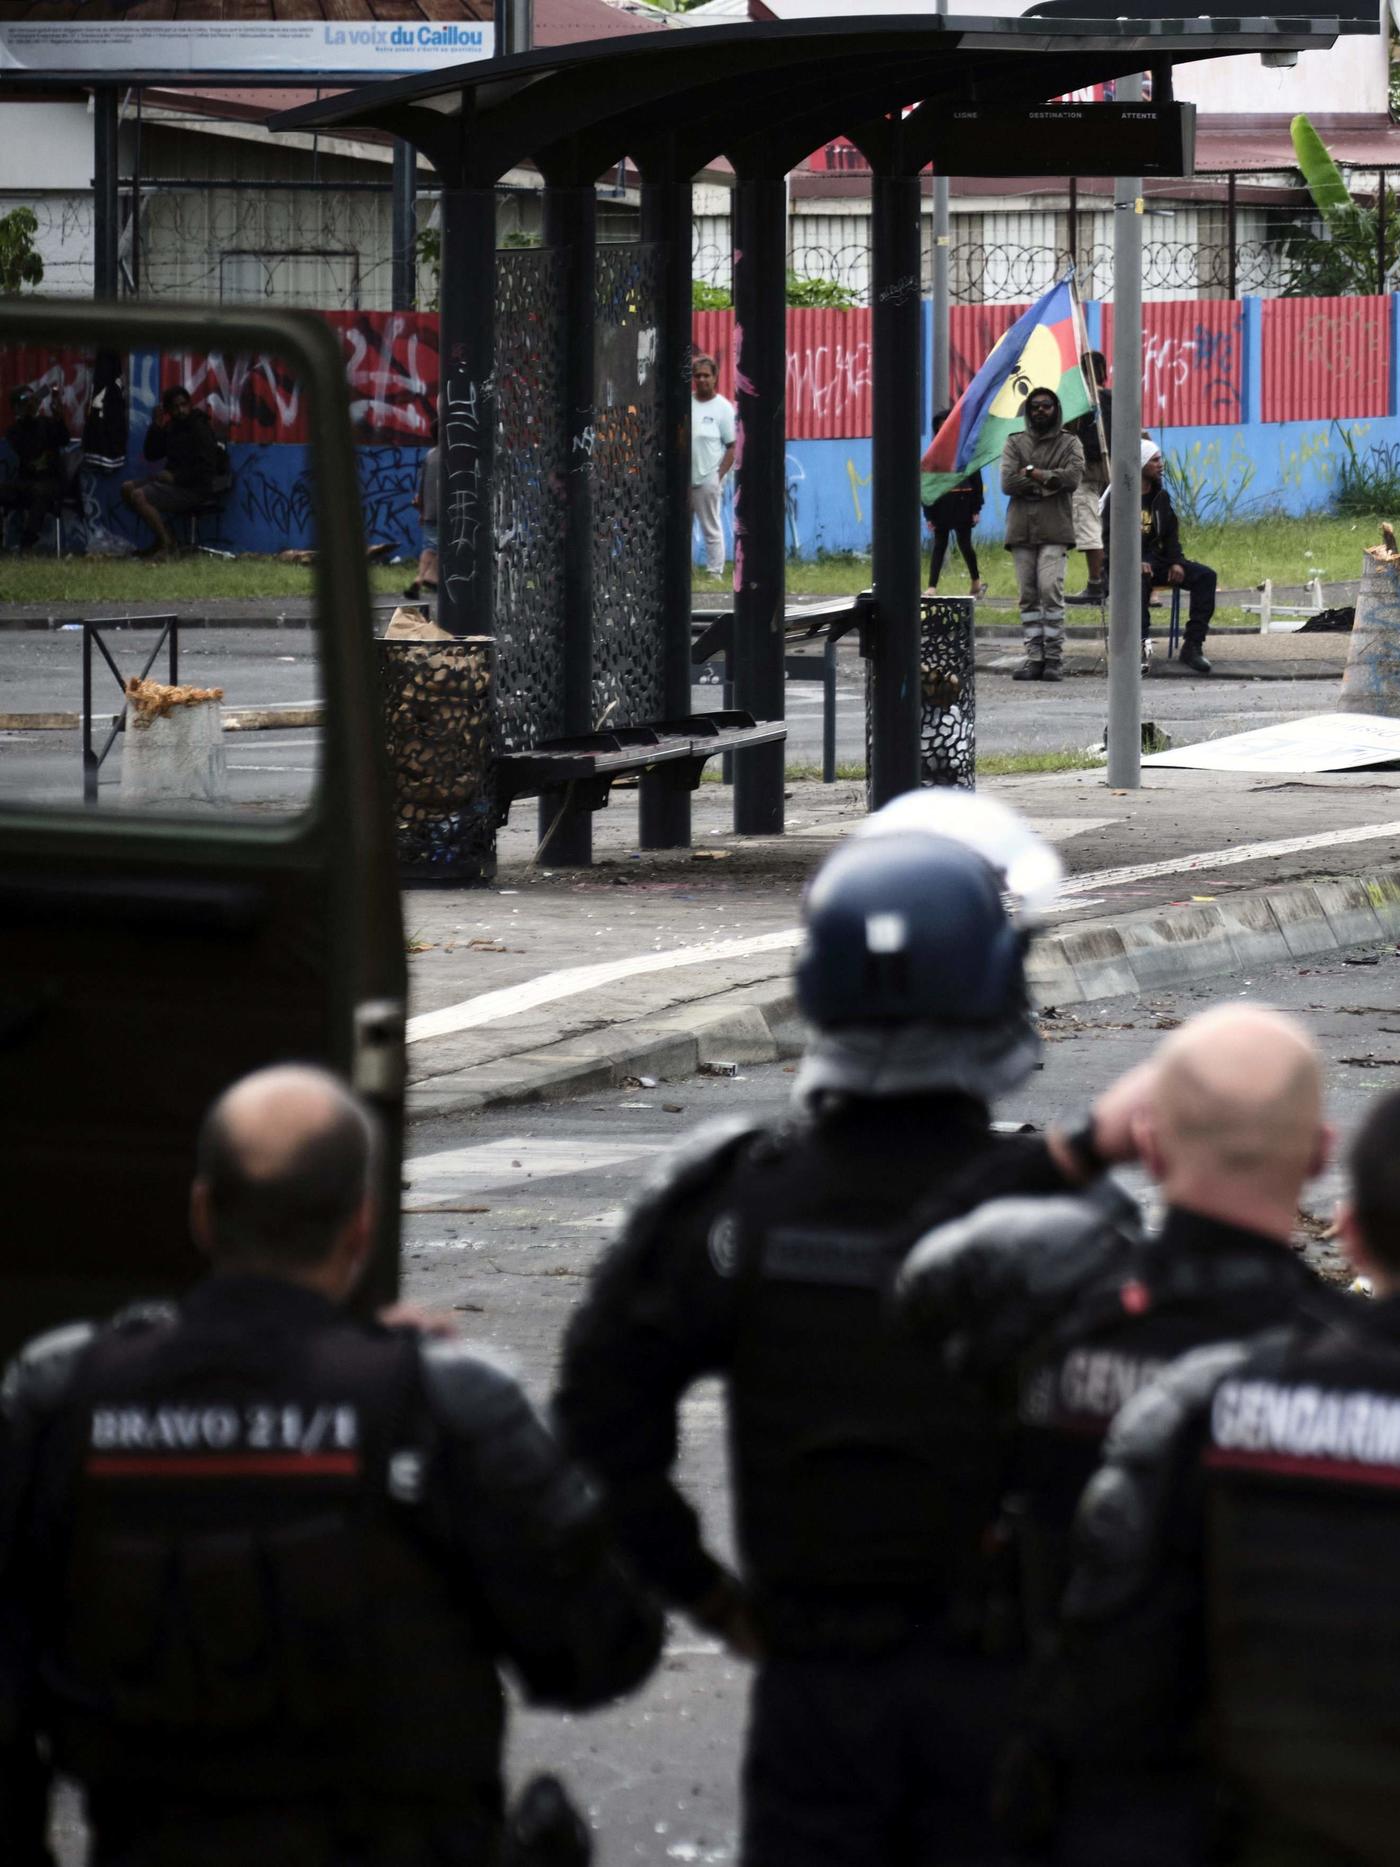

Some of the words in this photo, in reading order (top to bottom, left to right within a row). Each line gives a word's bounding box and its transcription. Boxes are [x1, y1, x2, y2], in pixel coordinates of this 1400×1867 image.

[324, 26, 346, 45] La
[349, 26, 387, 45] voix
[391, 25, 414, 45] du
[417, 26, 483, 45] Caillou
[91, 1403, 240, 1449] BRAVO
